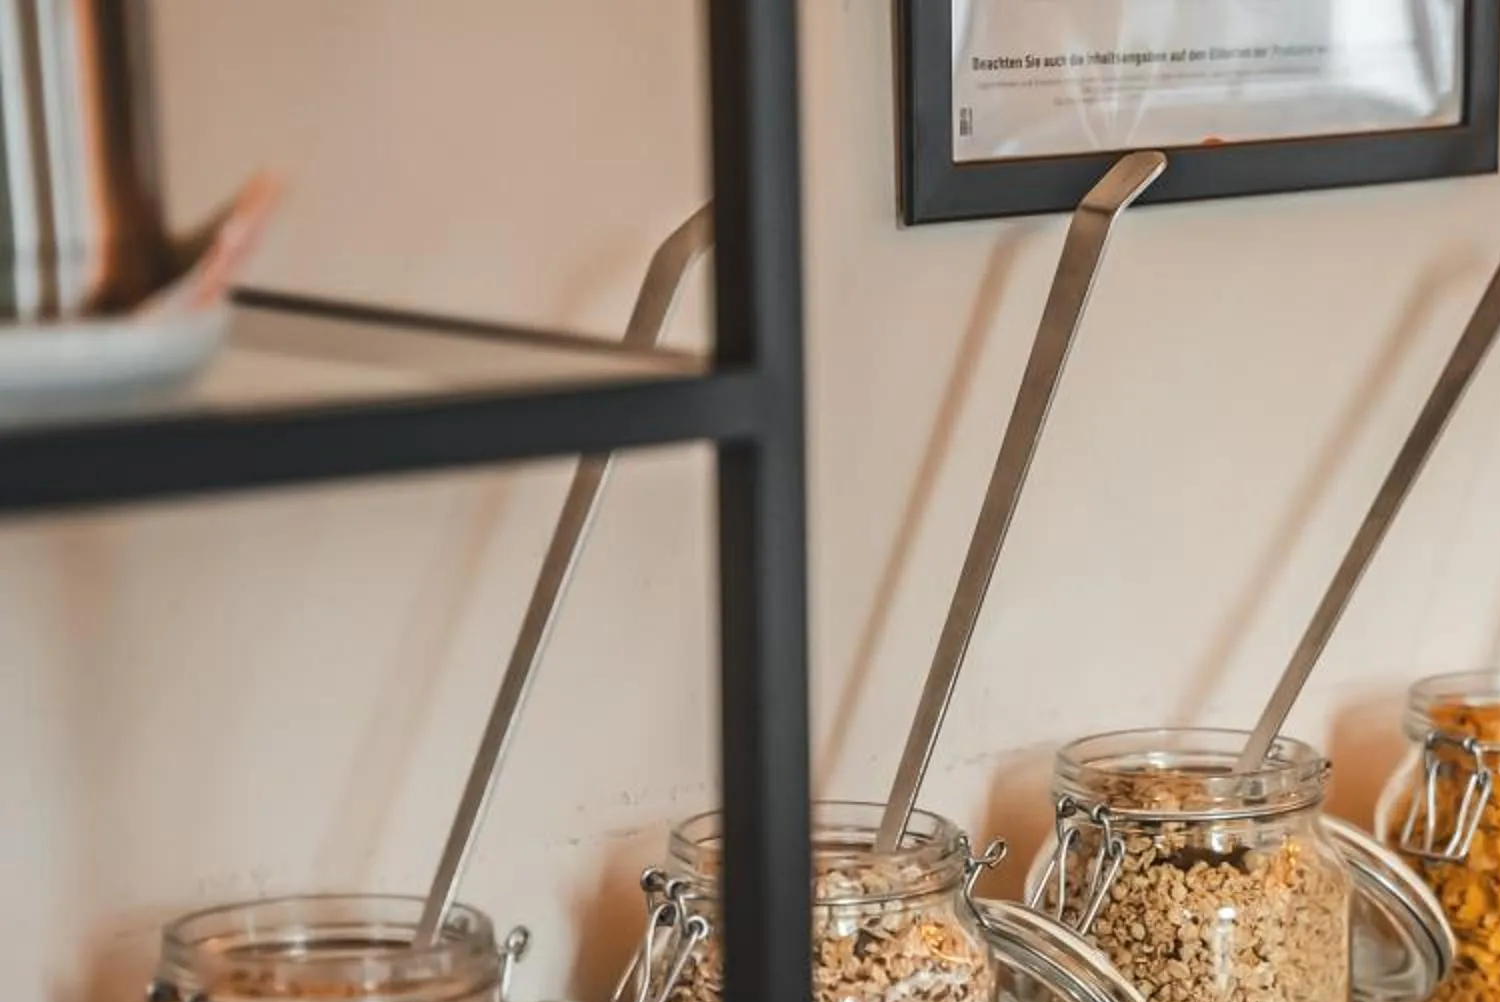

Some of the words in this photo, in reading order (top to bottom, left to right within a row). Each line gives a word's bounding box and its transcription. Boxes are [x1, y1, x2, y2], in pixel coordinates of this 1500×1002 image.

[972, 56, 1022, 70] Beachten
[1025, 54, 1041, 69] Sie
[1044, 54, 1066, 67] auch
[1170, 48, 1187, 62] auf
